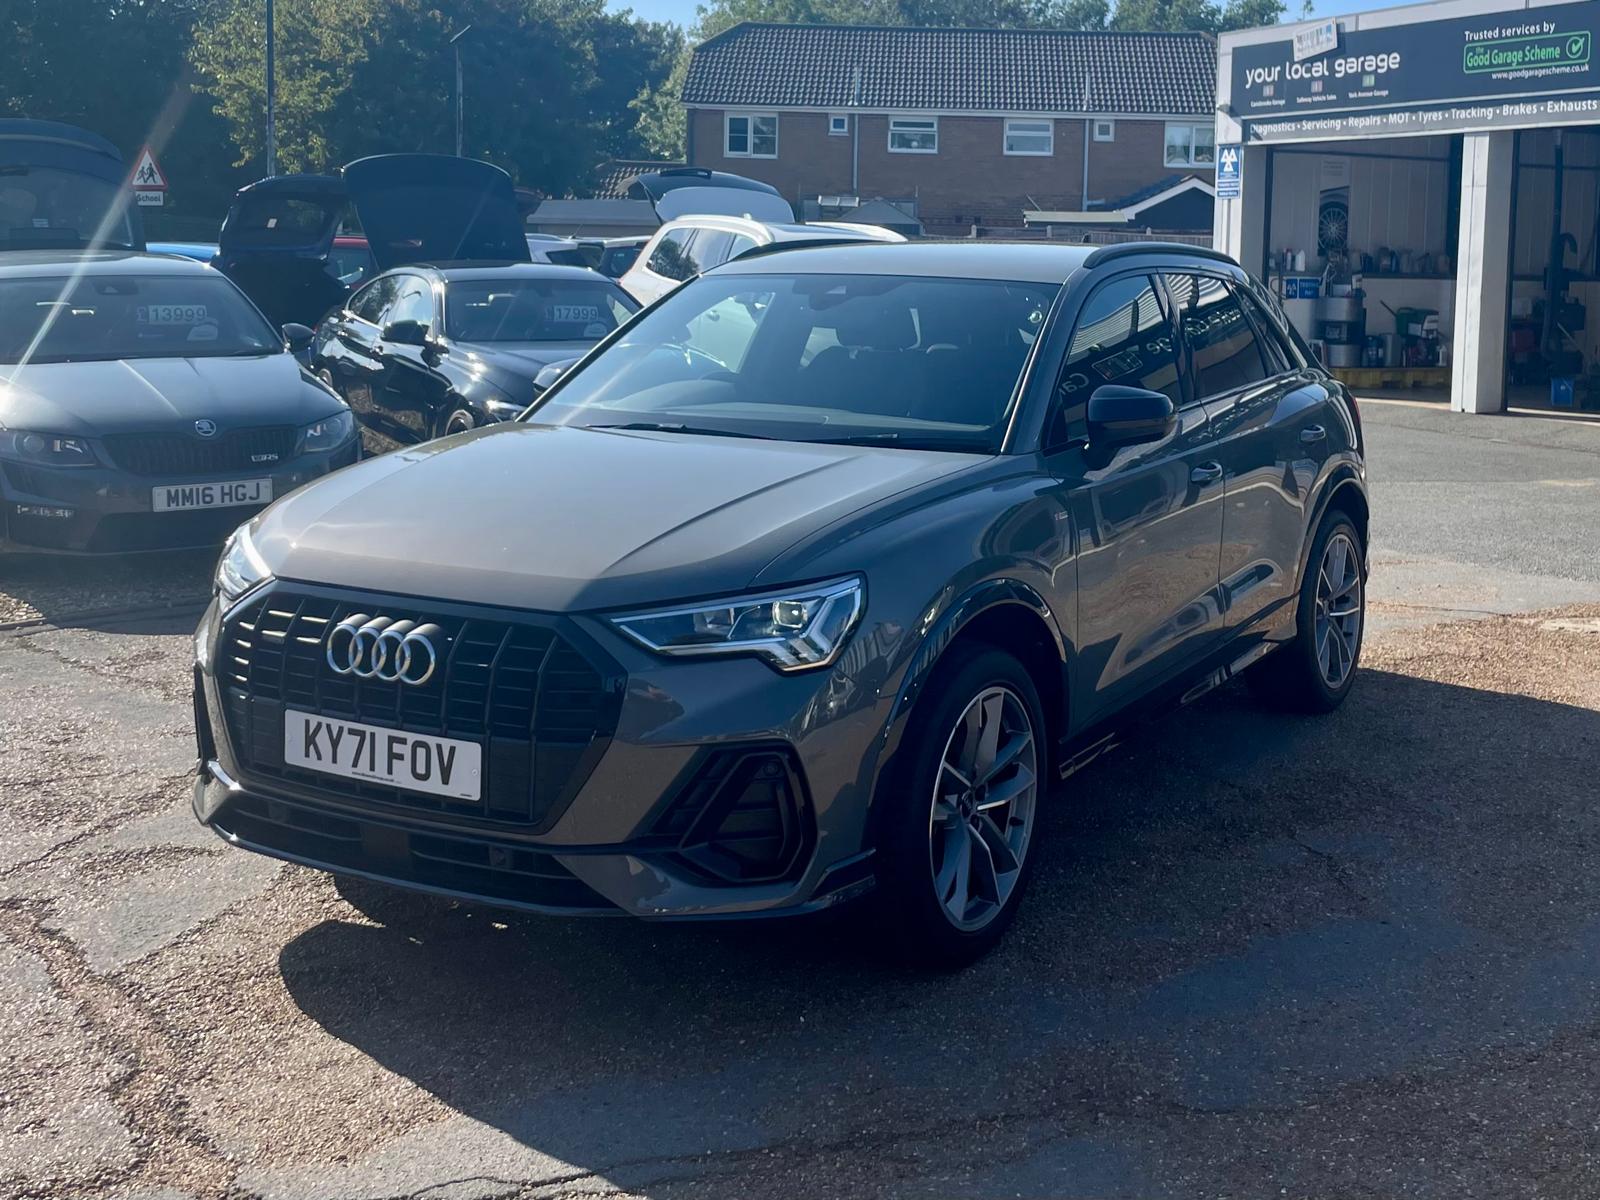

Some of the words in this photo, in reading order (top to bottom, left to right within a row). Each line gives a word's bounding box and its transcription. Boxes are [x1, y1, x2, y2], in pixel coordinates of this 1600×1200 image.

[1464, 27, 1499, 41] Trusted
[1501, 24, 1541, 38] services
[1543, 21, 1556, 34] by
[1466, 51, 1490, 67] Good
[1491, 49, 1523, 66] Garage
[1524, 45, 1561, 61] Scheme
[1245, 66, 1281, 89] your
[1286, 57, 1329, 80] local
[1334, 52, 1401, 78] garage
[1491, 64, 1590, 80] www.goodgaragescheme.co.uk
[1250, 121, 1296, 136] Diagnostics
[1301, 118, 1341, 131] Servicing
[1348, 115, 1381, 129] Repairs
[1388, 112, 1410, 124] MOT
[1418, 110, 1443, 124] Tyres
[1450, 106, 1493, 120] Tracking
[1502, 103, 1538, 116] Brakes
[1546, 99, 1598, 113] Exhausts
[166, 486, 214, 508] MM16
[220, 482, 260, 503] HGJ
[304, 718, 376, 772] KY71
[386, 734, 457, 786] FOV
